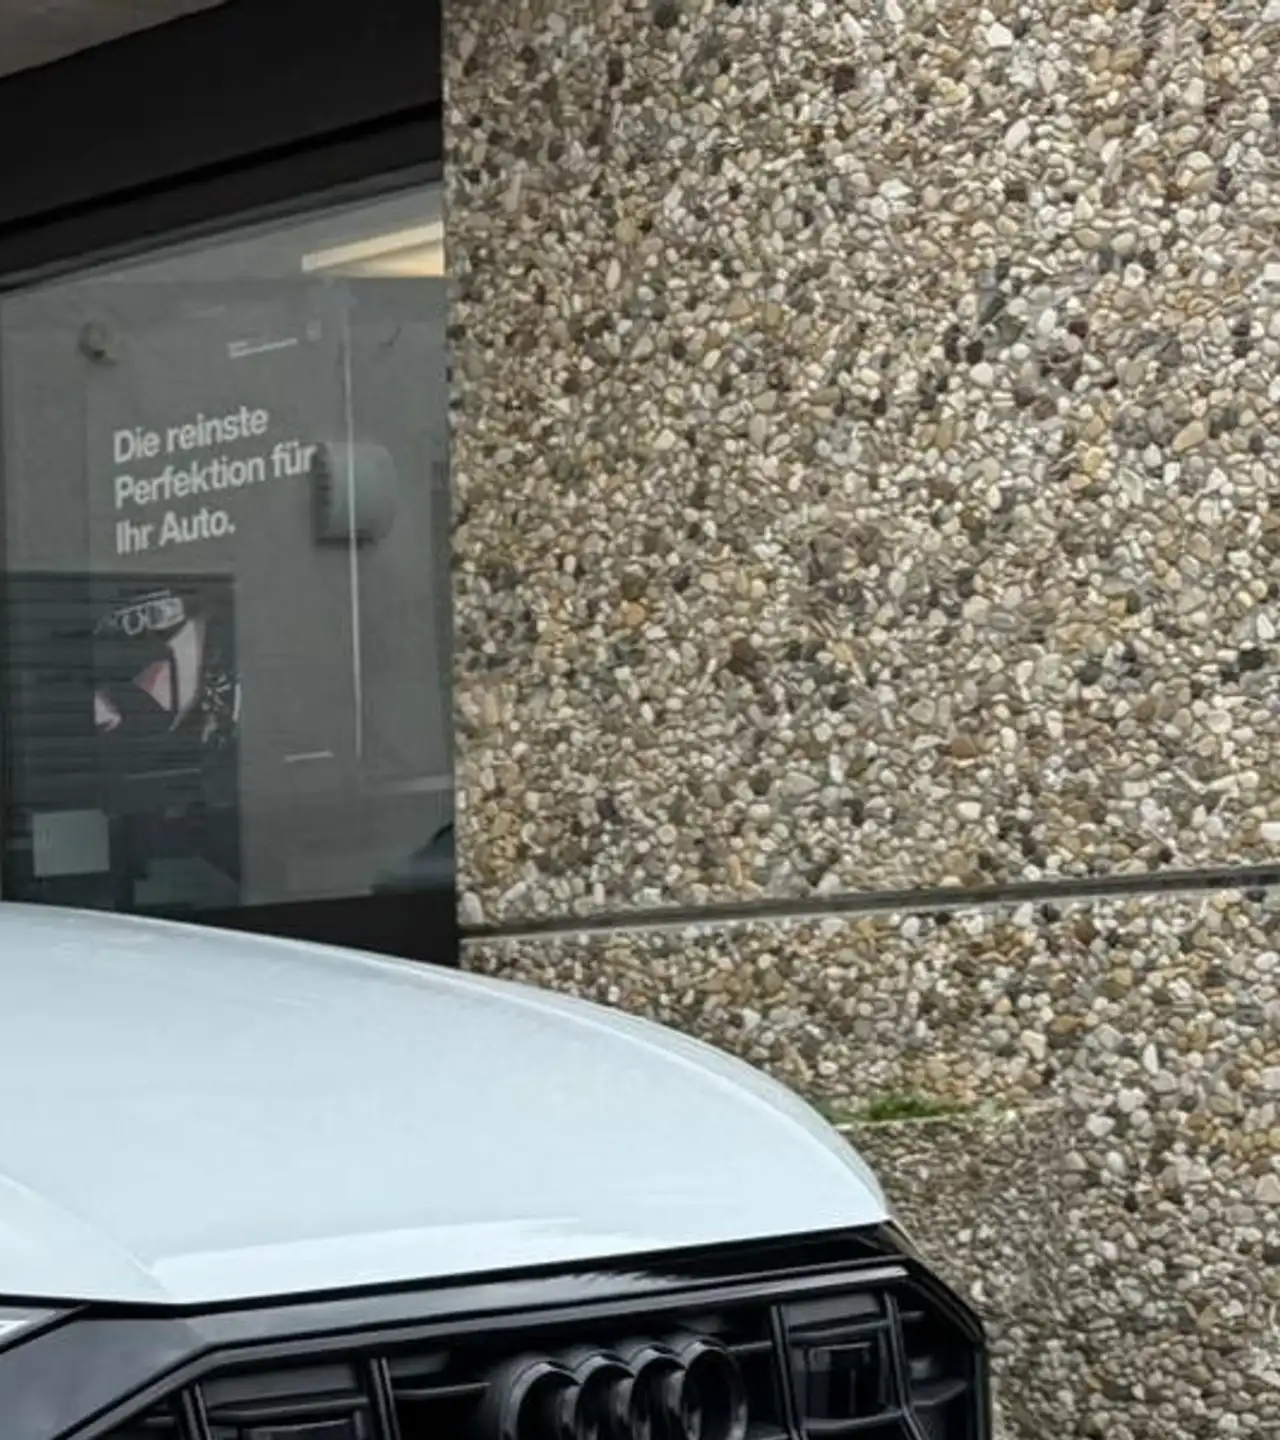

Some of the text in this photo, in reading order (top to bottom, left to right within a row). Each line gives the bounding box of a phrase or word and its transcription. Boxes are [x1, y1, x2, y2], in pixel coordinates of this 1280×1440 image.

[113, 405, 269, 464] Die reinste
[113, 437, 318, 510] Perfektion für
[115, 506, 237, 556] Ihr Auto.
